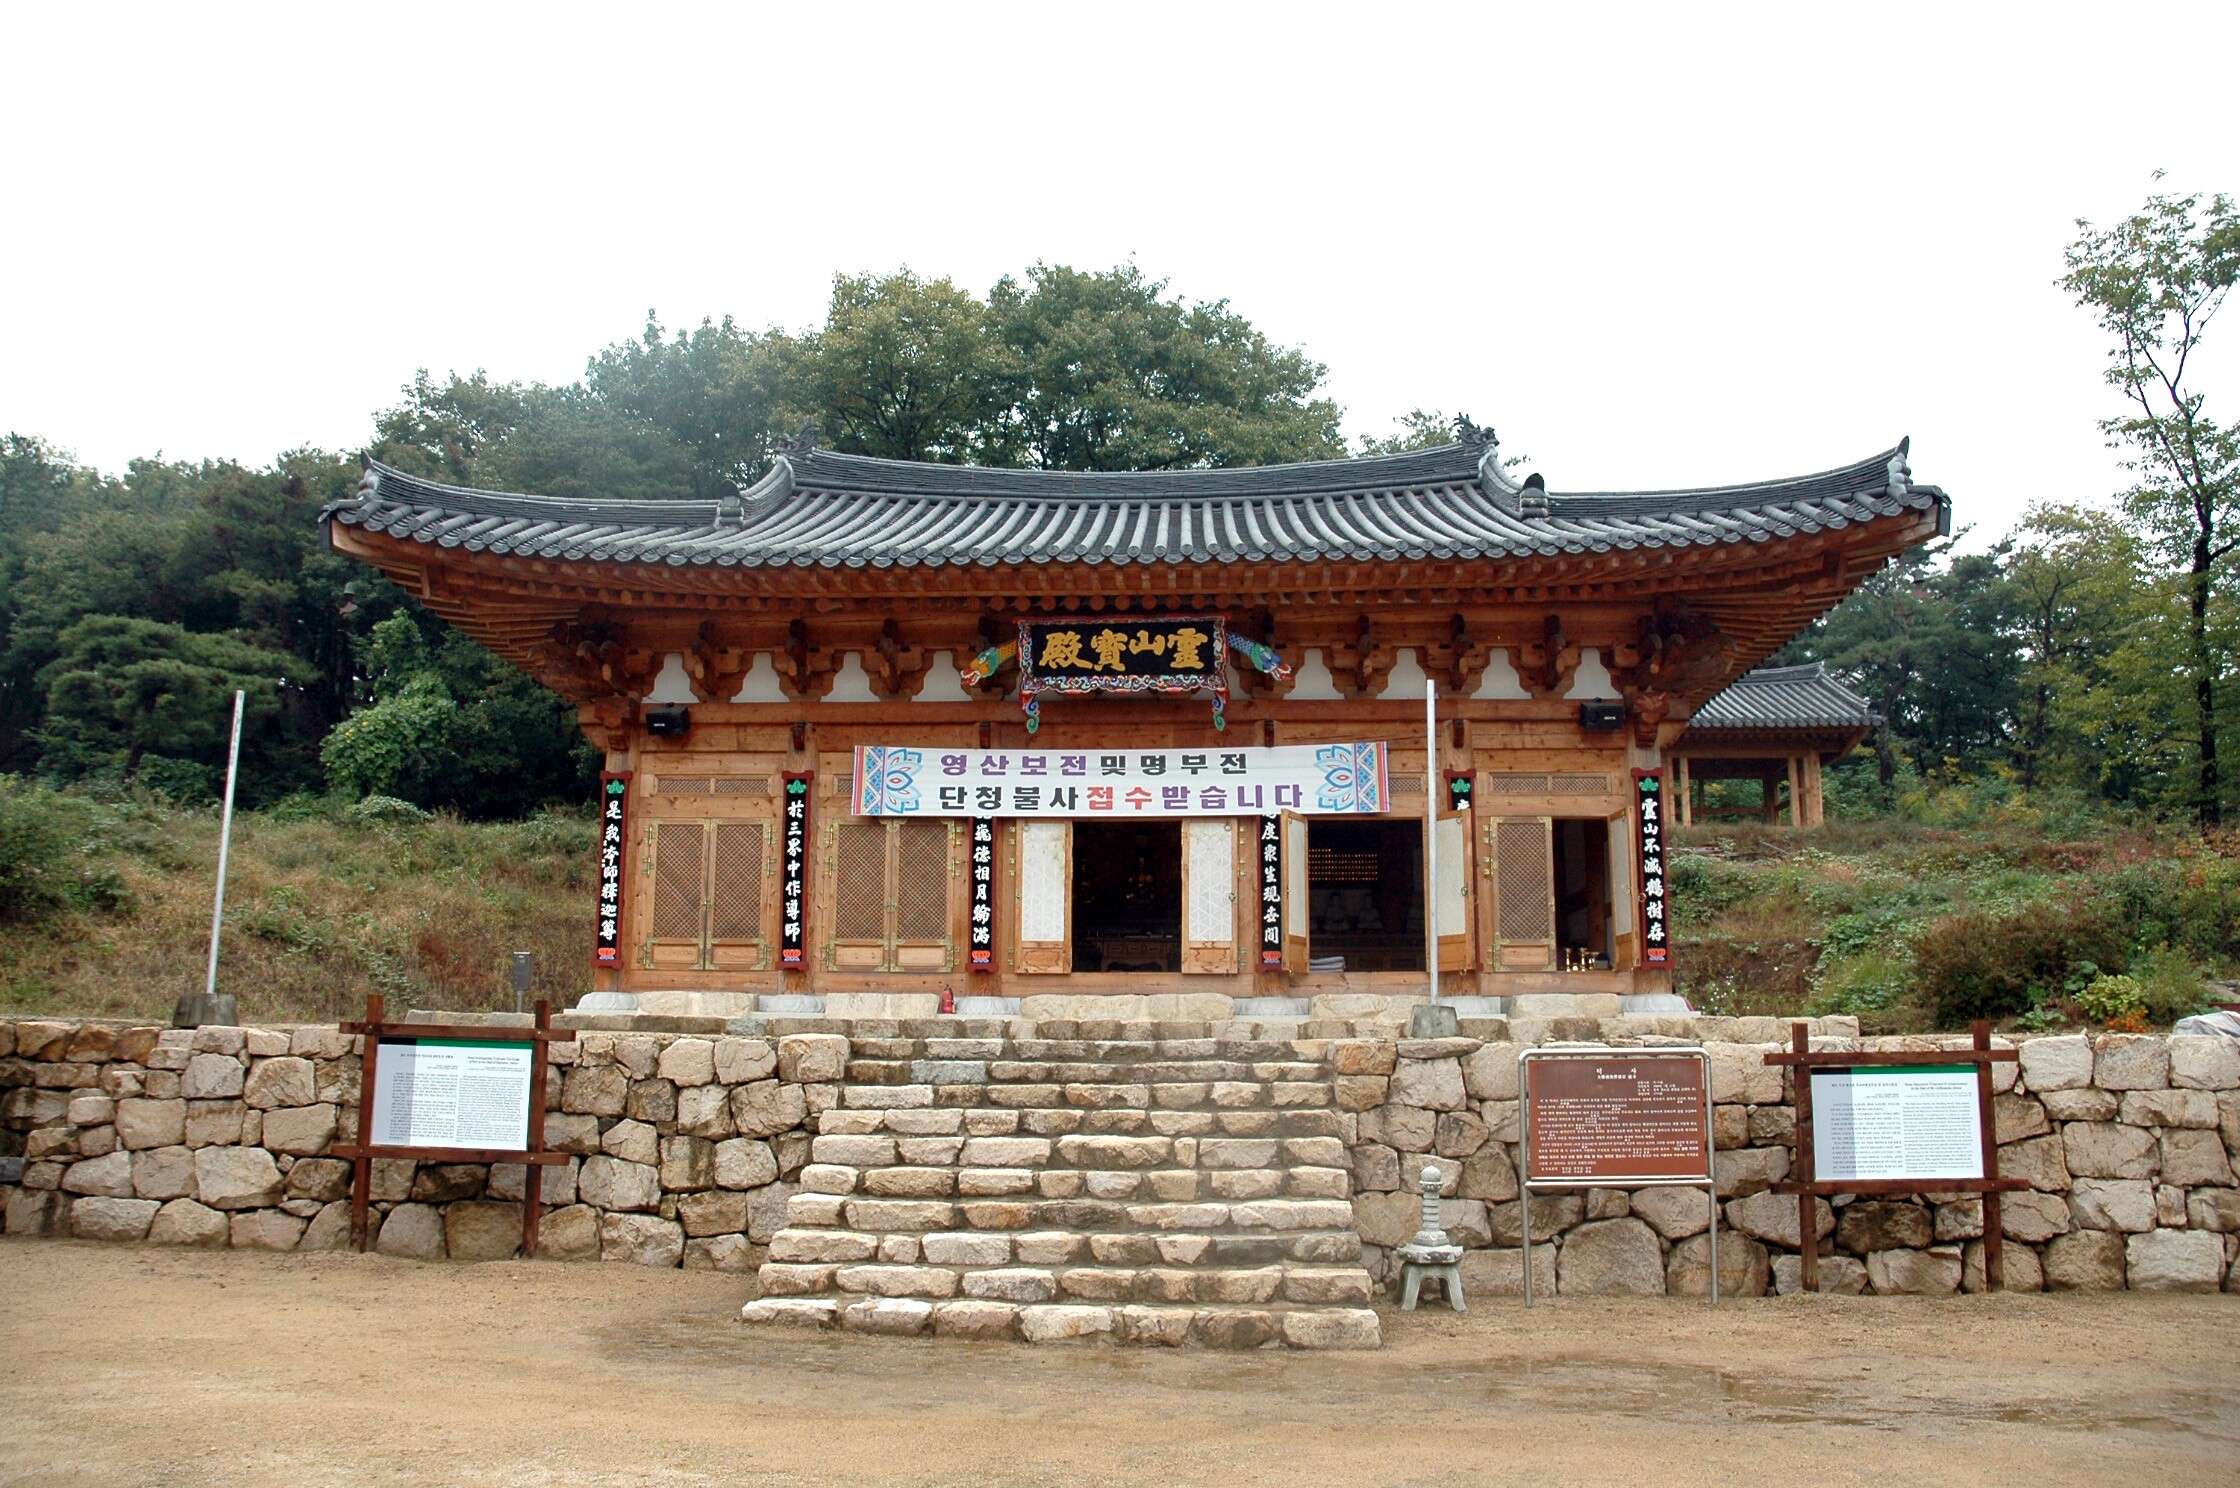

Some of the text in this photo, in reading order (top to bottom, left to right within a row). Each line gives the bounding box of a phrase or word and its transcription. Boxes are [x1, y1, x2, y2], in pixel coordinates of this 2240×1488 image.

[972, 814, 993, 944] 巍德相月輪滿
